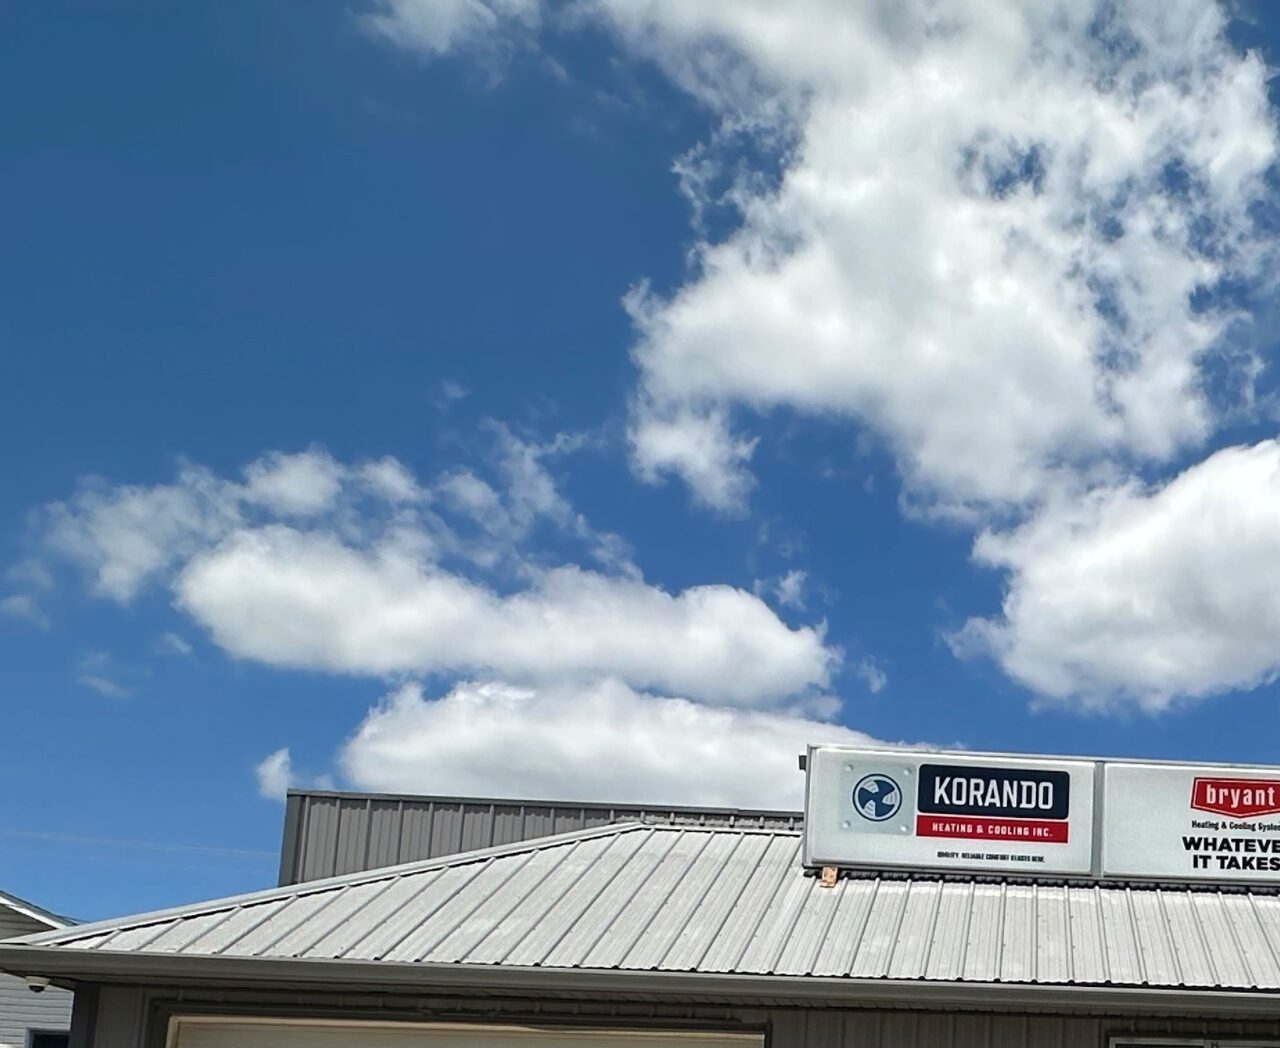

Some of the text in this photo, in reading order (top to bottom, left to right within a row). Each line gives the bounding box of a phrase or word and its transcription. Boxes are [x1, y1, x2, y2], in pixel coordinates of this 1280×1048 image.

[933, 776, 1054, 809] KORANDO
[1206, 784, 1275, 808] bryant
[932, 822, 1053, 837] HEATING & COOLING INC.
[1191, 820, 1219, 831] Heating
[1229, 822, 1256, 832] Cooling
[1193, 854, 1211, 869] IT
